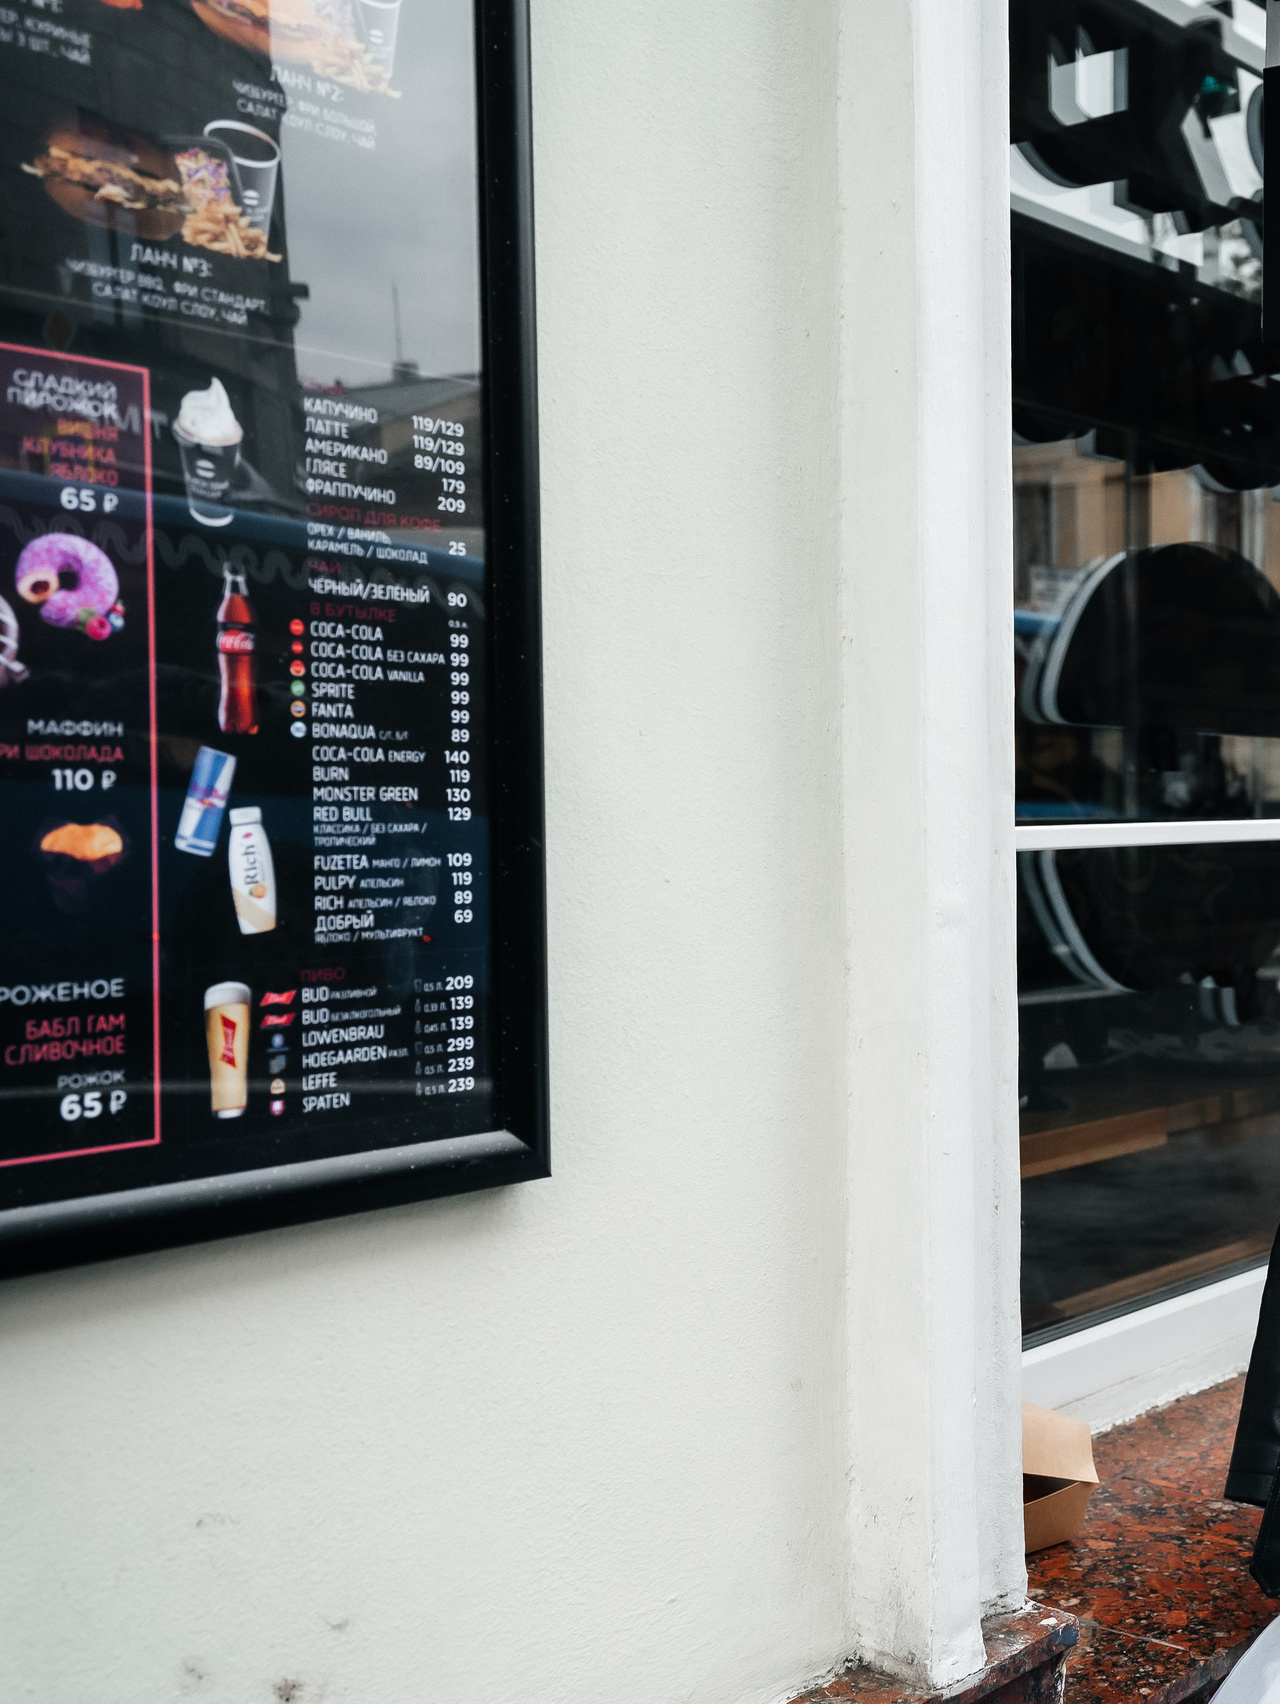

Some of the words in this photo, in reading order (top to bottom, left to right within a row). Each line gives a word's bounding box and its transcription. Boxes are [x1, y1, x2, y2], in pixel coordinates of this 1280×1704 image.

[270, 65, 312, 93] ЛАНЧ
[236, 99, 277, 120] САЛАТ
[130, 243, 178, 270] ЛАНЧ
[92, 281, 138, 301] САЛАТ
[12, 368, 117, 400] СЛАДКИЙ
[7, 386, 118, 420] ПИРОЖОК
[304, 396, 378, 424] КАПУЧИНО
[412, 415, 464, 437] 119/129
[305, 416, 349, 439] ЛАТТЕ
[413, 434, 465, 456] 119/129
[305, 437, 388, 464] АМЕРИКАНО
[414, 454, 465, 476] 89/109
[306, 457, 347, 479] ГЛЯСЕ
[441, 478, 466, 494] 179
[60, 487, 97, 512] 65
[306, 477, 396, 505] ФРАППУЧИНО
[437, 496, 466, 513] 209
[306, 502, 361, 520] СИРОП
[364, 510, 397, 526] ДЛЯ
[401, 515, 440, 533] КОФЕ
[307, 521, 335, 537] ОРЕХ
[347, 527, 393, 545] ВАНИЛЬ
[449, 541, 467, 557] 25
[307, 539, 366, 557] КАРАМЕЛЬ
[376, 547, 429, 565] ШОКОЛАД
[308, 559, 341, 574] ЧАЙ
[310, 602, 320, 615] В
[325, 602, 397, 622] БУТЫЛКЕ
[447, 592, 467, 607] 90
[310, 621, 384, 641] COCA-COLA
[450, 633, 469, 648] 99
[310, 641, 384, 661] COCA-COLA
[386, 649, 405, 663] БЕЗ
[407, 651, 446, 665] САХАРА
[450, 652, 469, 667] 99
[310, 661, 384, 681] COCA-COLA
[386, 669, 425, 683] VANILLA
[450, 671, 470, 686] 99
[311, 682, 356, 699] SPRITE
[450, 690, 470, 705] 99
[311, 702, 355, 719] FANTA
[450, 709, 470, 724] 99
[27, 718, 124, 737] МАФФИН
[312, 722, 377, 740] BONAQUA
[451, 728, 470, 743] 89
[25, 743, 124, 763] ШОКОЛАДА
[312, 745, 385, 762] COCA-COLA
[388, 751, 426, 763] ENERGY
[444, 750, 470, 764] 140
[51, 768, 94, 791] 110
[312, 766, 350, 782] BURN
[449, 769, 470, 783] 119
[312, 786, 376, 802] MONSTER
[379, 786, 419, 802] GREEN
[446, 788, 471, 802] 130
[313, 806, 339, 822] RED
[342, 806, 373, 822] BULL
[447, 807, 472, 821] 129
[313, 824, 360, 835] КЛАССИКА
[370, 823, 386, 834] БЕЗ
[387, 823, 420, 833] САХАРА
[314, 834, 377, 847] ТРОПИЧЕСКИЙ
[243, 844, 259, 885] Rich
[314, 854, 370, 871] FUZETEA
[371, 858, 401, 869] МАНГО
[410, 857, 441, 868] ЛИМОН
[447, 852, 473, 867] 109
[314, 875, 357, 891] PULPY
[359, 878, 405, 889] АПЕЛЬСИН
[452, 871, 473, 885] 119
[314, 895, 345, 911] RICH
[347, 898, 393, 909] АПЕЛЬСИН
[402, 895, 437, 907] ЯБЛОКО
[454, 890, 473, 905] 89
[314, 909, 375, 933] ДОБРЫЙ
[454, 909, 473, 924] 69
[315, 932, 352, 944] ЯБЛОКО
[361, 927, 424, 940] МУЛЬТИФРУКТ
[301, 967, 346, 982] ПИВО
[302, 986, 330, 1003] BUD
[445, 975, 474, 991] 209
[302, 1007, 330, 1025] BUD
[450, 995, 474, 1010] 139
[25, 1016, 80, 1040] БАБЛ
[87, 1013, 125, 1034] ГАМ
[302, 1024, 385, 1047] LOWENBRAU
[450, 1015, 474, 1031] 139
[5, 1034, 125, 1066] СЛИВОЧНОЕ
[302, 1045, 387, 1069] HOEGAARDEN
[447, 1036, 474, 1052] 299
[57, 1070, 126, 1090] РОЖОК
[302, 1071, 338, 1091] LEFFE
[447, 1056, 475, 1073] 239
[60, 1091, 103, 1121] 65
[302, 1092, 350, 1114] SPATEN
[447, 1076, 475, 1093] 239
